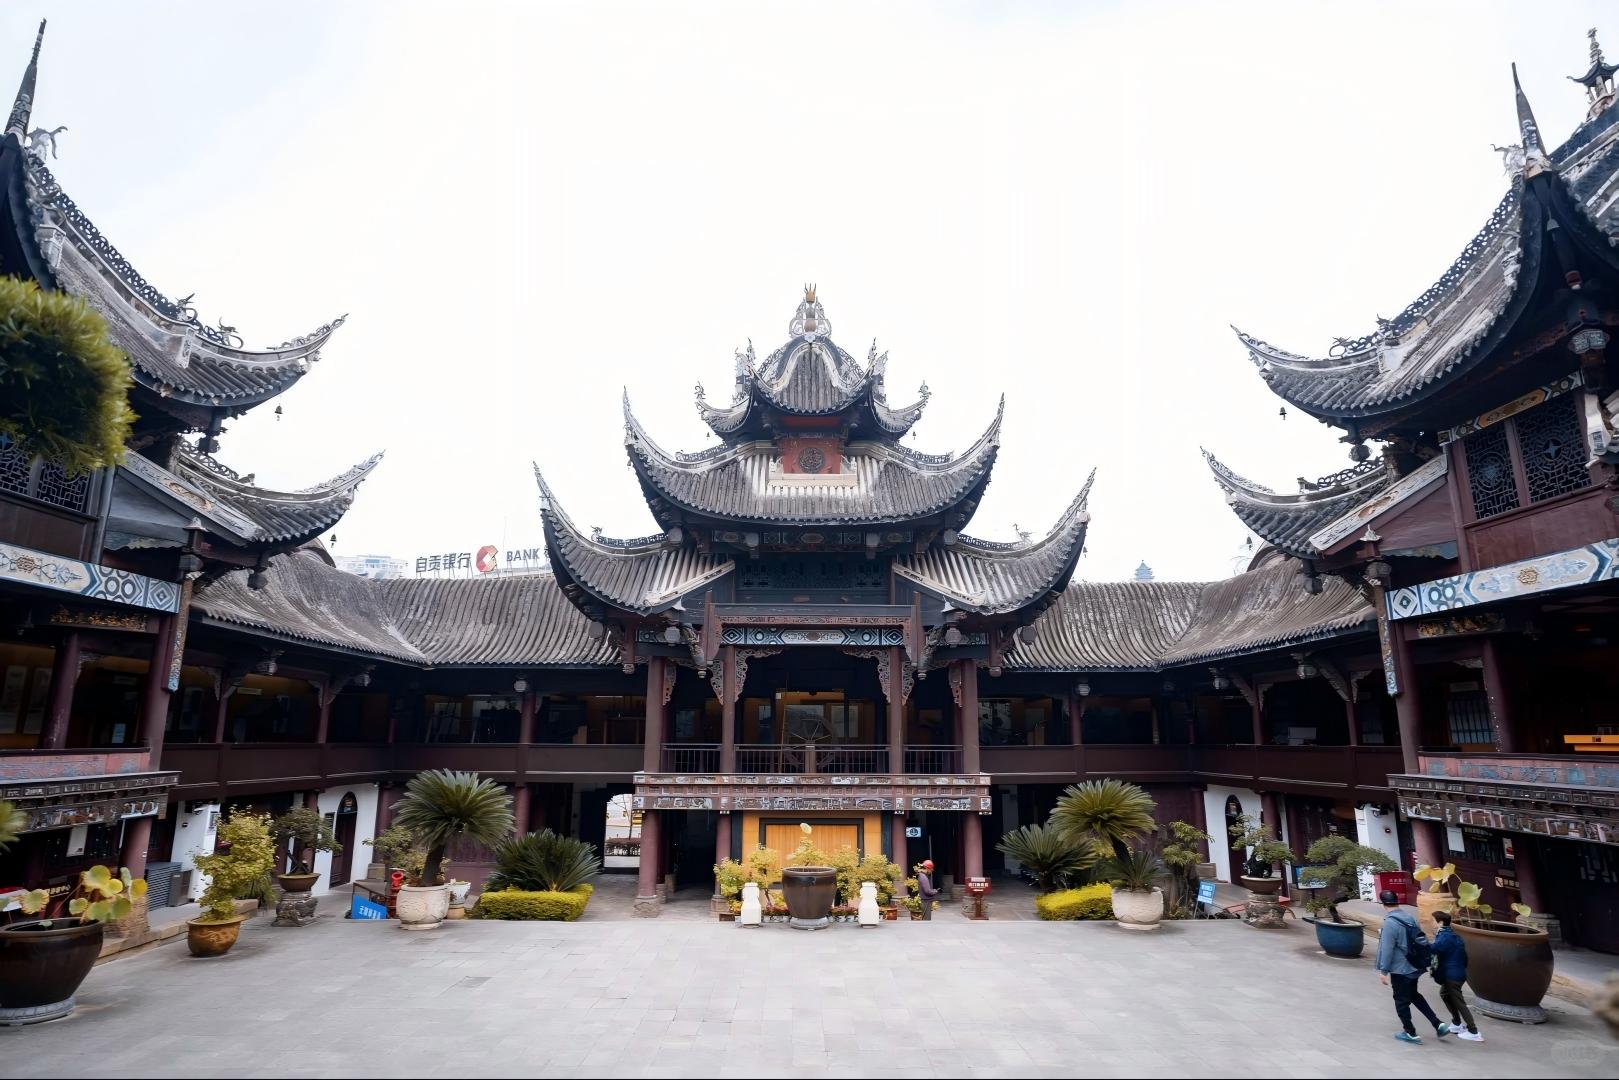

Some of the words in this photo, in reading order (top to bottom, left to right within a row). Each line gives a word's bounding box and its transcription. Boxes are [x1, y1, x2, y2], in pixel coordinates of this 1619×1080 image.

[415, 552, 471, 573] 自贡银行
[506, 547, 540, 561] BANK
